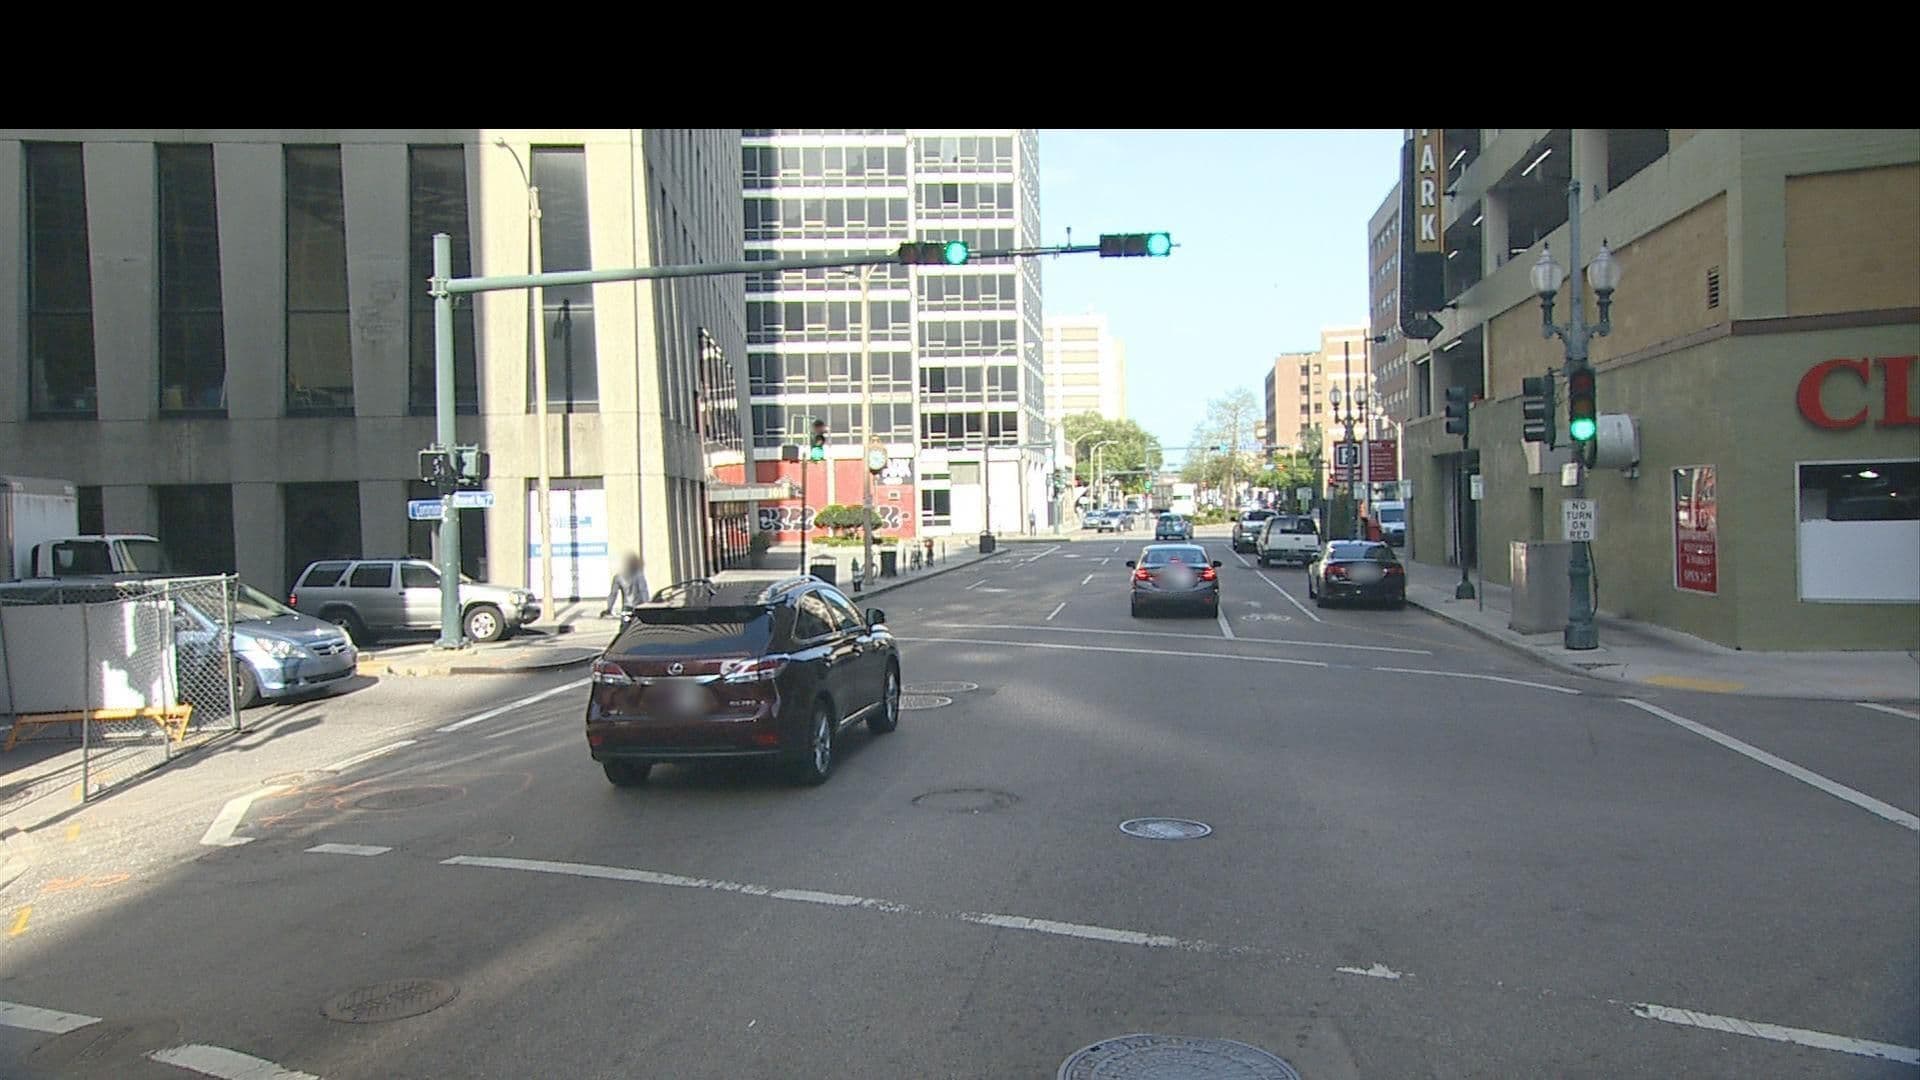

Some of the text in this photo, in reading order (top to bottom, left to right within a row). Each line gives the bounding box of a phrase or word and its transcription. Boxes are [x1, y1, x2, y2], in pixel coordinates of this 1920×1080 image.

[1572, 501, 1587, 510] NO
[1567, 511, 1592, 520] TURN
[1572, 521, 1586, 529] ON
[1570, 530, 1590, 539] RED
